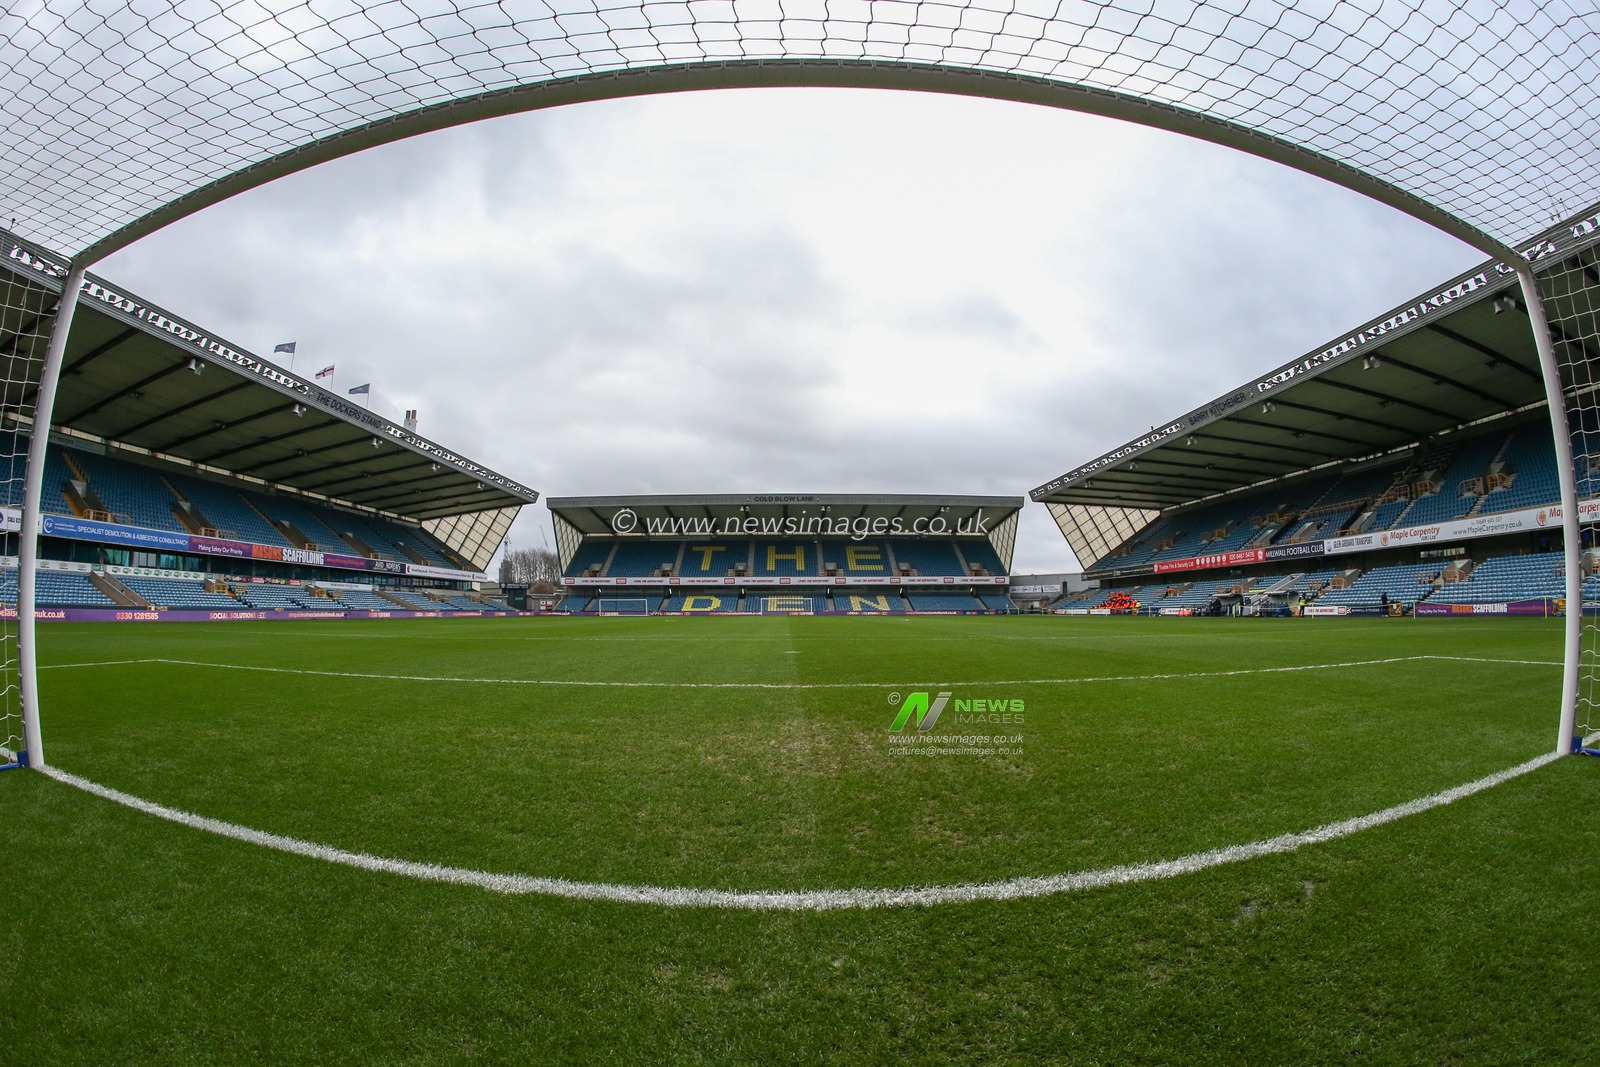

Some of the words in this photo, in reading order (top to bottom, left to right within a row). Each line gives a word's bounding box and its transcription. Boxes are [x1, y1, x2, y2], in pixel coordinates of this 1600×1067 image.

[317, 392, 330, 406] THE
[330, 400, 361, 420] DOCKERS
[361, 413, 382, 428] STAND
[1189, 410, 1208, 425] BARRY
[1210, 392, 1246, 416] KITCHENER
[78, 525, 104, 535] SPECIALIST
[105, 528, 132, 539] DEMOLITION
[137, 532, 158, 542] ASBESTOS
[159, 536, 188, 546] CONSULTANCY
[1390, 530, 1408, 540] Maple
[1410, 527, 1440, 537] Carpentry
[1453, 520, 1522, 535] www.MapleCarpentry.co.uk
[252, 544, 282, 560] MASONS
[283, 548, 324, 564] SCAFFOLDING
[1266, 549, 1286, 558] MILLWALL
[1287, 546, 1311, 556] FOOTBALL
[1311, 544, 1323, 553] CLUB
[1473, 604, 1507, 613] SCAFFOLDING
